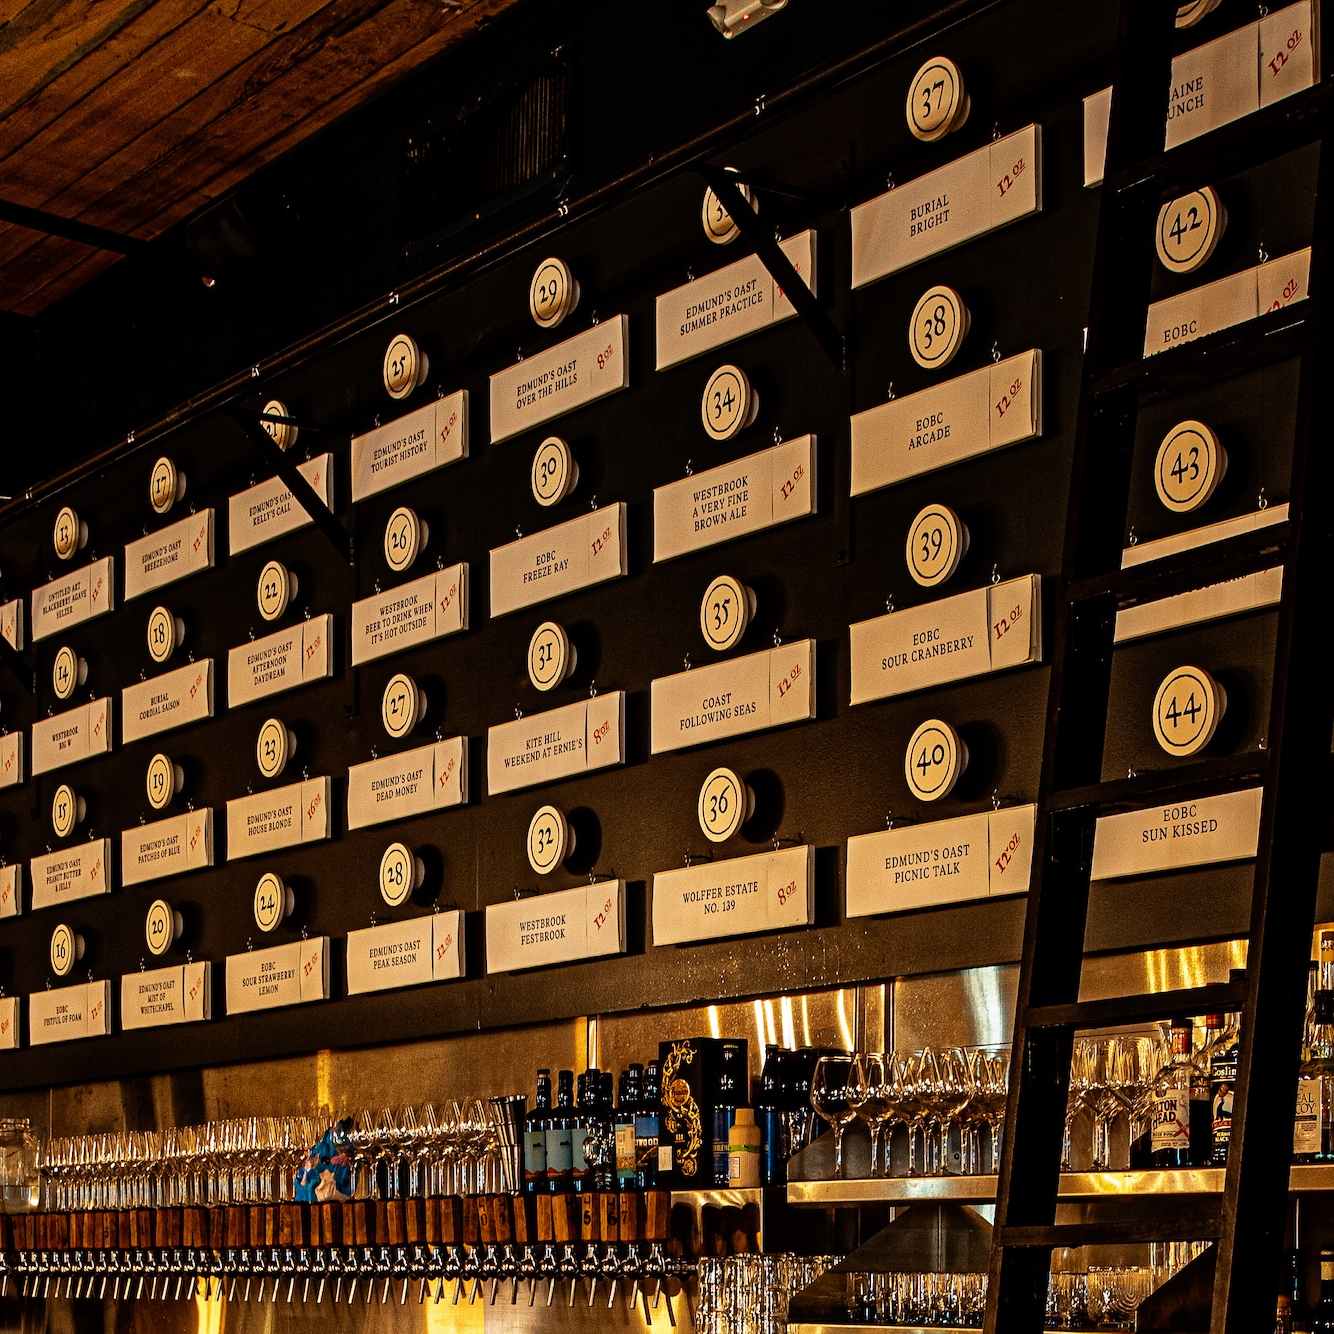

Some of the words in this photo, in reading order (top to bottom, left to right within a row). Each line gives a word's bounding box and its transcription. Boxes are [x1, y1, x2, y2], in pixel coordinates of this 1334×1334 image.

[922, 80, 944, 118] 37
[910, 195, 949, 222] BURIAL
[910, 210, 950, 237] BRIGHT
[1169, 207, 1202, 245] 42
[539, 280, 558, 307] 29
[686, 291, 732, 320] EDMUND'S
[734, 279, 757, 298] OAST
[680, 312, 718, 336] SUMMER
[720, 291, 763, 319] PRACTICE
[924, 305, 945, 349] 38
[1163, 321, 1197, 343] EOBC
[517, 372, 555, 397] EDMUND'S
[557, 360, 577, 377] OAST
[517, 392, 537, 410] OVER
[539, 386, 553, 401] THE
[555, 374, 578, 393] HILLS
[714, 387, 735, 419] 34
[916, 412, 944, 432] EOBC
[908, 425, 951, 451] ARCADE
[541, 458, 557, 488] 30
[1171, 447, 1200, 484] 43
[693, 475, 749, 503] WESTBROOK
[692, 507, 699, 518] A
[701, 498, 725, 515] VERY
[727, 491, 749, 507] FINE
[694, 513, 727, 532] BROWN
[729, 505, 747, 519] ALE
[392, 524, 407, 550] 26
[921, 528, 942, 562] 39
[536, 550, 556, 566] EOBC
[523, 566, 553, 584] FREEZE
[553, 559, 569, 574] RAY
[379, 594, 419, 616] WESTBROOK
[713, 598, 731, 630] 35
[913, 629, 940, 646] EOBC
[539, 642, 553, 670] 31
[881, 653, 909, 670] SOUR
[911, 636, 974, 662] CRANBERRY
[139, 705, 160, 721] CORDIAL
[162, 699, 180, 713] SAISON
[151, 692, 169, 706] BURIAL
[391, 694, 405, 717] 27
[702, 693, 731, 710] COAST
[1165, 692, 1202, 728] 44
[680, 708, 732, 730] FOLLOWING
[734, 702, 756, 717] SEAS
[525, 736, 543, 750] KITE
[545, 731, 561, 746] HILL
[504, 750, 541, 768] WEEKEND
[542, 748, 552, 758] AT
[553, 739, 583, 756] ERNIE'S
[917, 744, 944, 777] 40
[153, 772, 164, 795] 19
[371, 774, 406, 792] EDMUND'S
[407, 770, 423, 782] OAST
[377, 790, 394, 802] DEAD
[395, 784, 417, 798] MONEY
[710, 784, 731, 822] 36
[1163, 805, 1197, 822] EOBC
[538, 827, 553, 854] 32
[1142, 827, 1168, 842] SUN
[1172, 819, 1218, 838] KISSED
[885, 848, 939, 870] EDMUND'S
[942, 844, 970, 860] OAST
[387, 862, 403, 886] 28
[895, 867, 930, 884] PICNIC
[933, 862, 960, 876] TALK
[260, 893, 274, 915] 24
[683, 888, 723, 903] WOLFFER
[726, 881, 759, 897] ESTATE
[704, 903, 720, 914] NO.
[722, 901, 736, 912] 139
[152, 919, 163, 935] 20
[519, 914, 567, 932] WESTBROOK
[56, 940, 66, 959] 16
[369, 943, 403, 958] EDMUND'S
[404, 940, 421, 952] OAST
[521, 928, 565, 946] FESTBROOK
[261, 961, 276, 973] EOBC
[373, 958, 391, 970] PEAK
[391, 953, 417, 966] SEASON
[242, 974, 257, 988] SOUR
[258, 969, 295, 985] STRAWBERRY
[259, 984, 279, 996] LEMON
